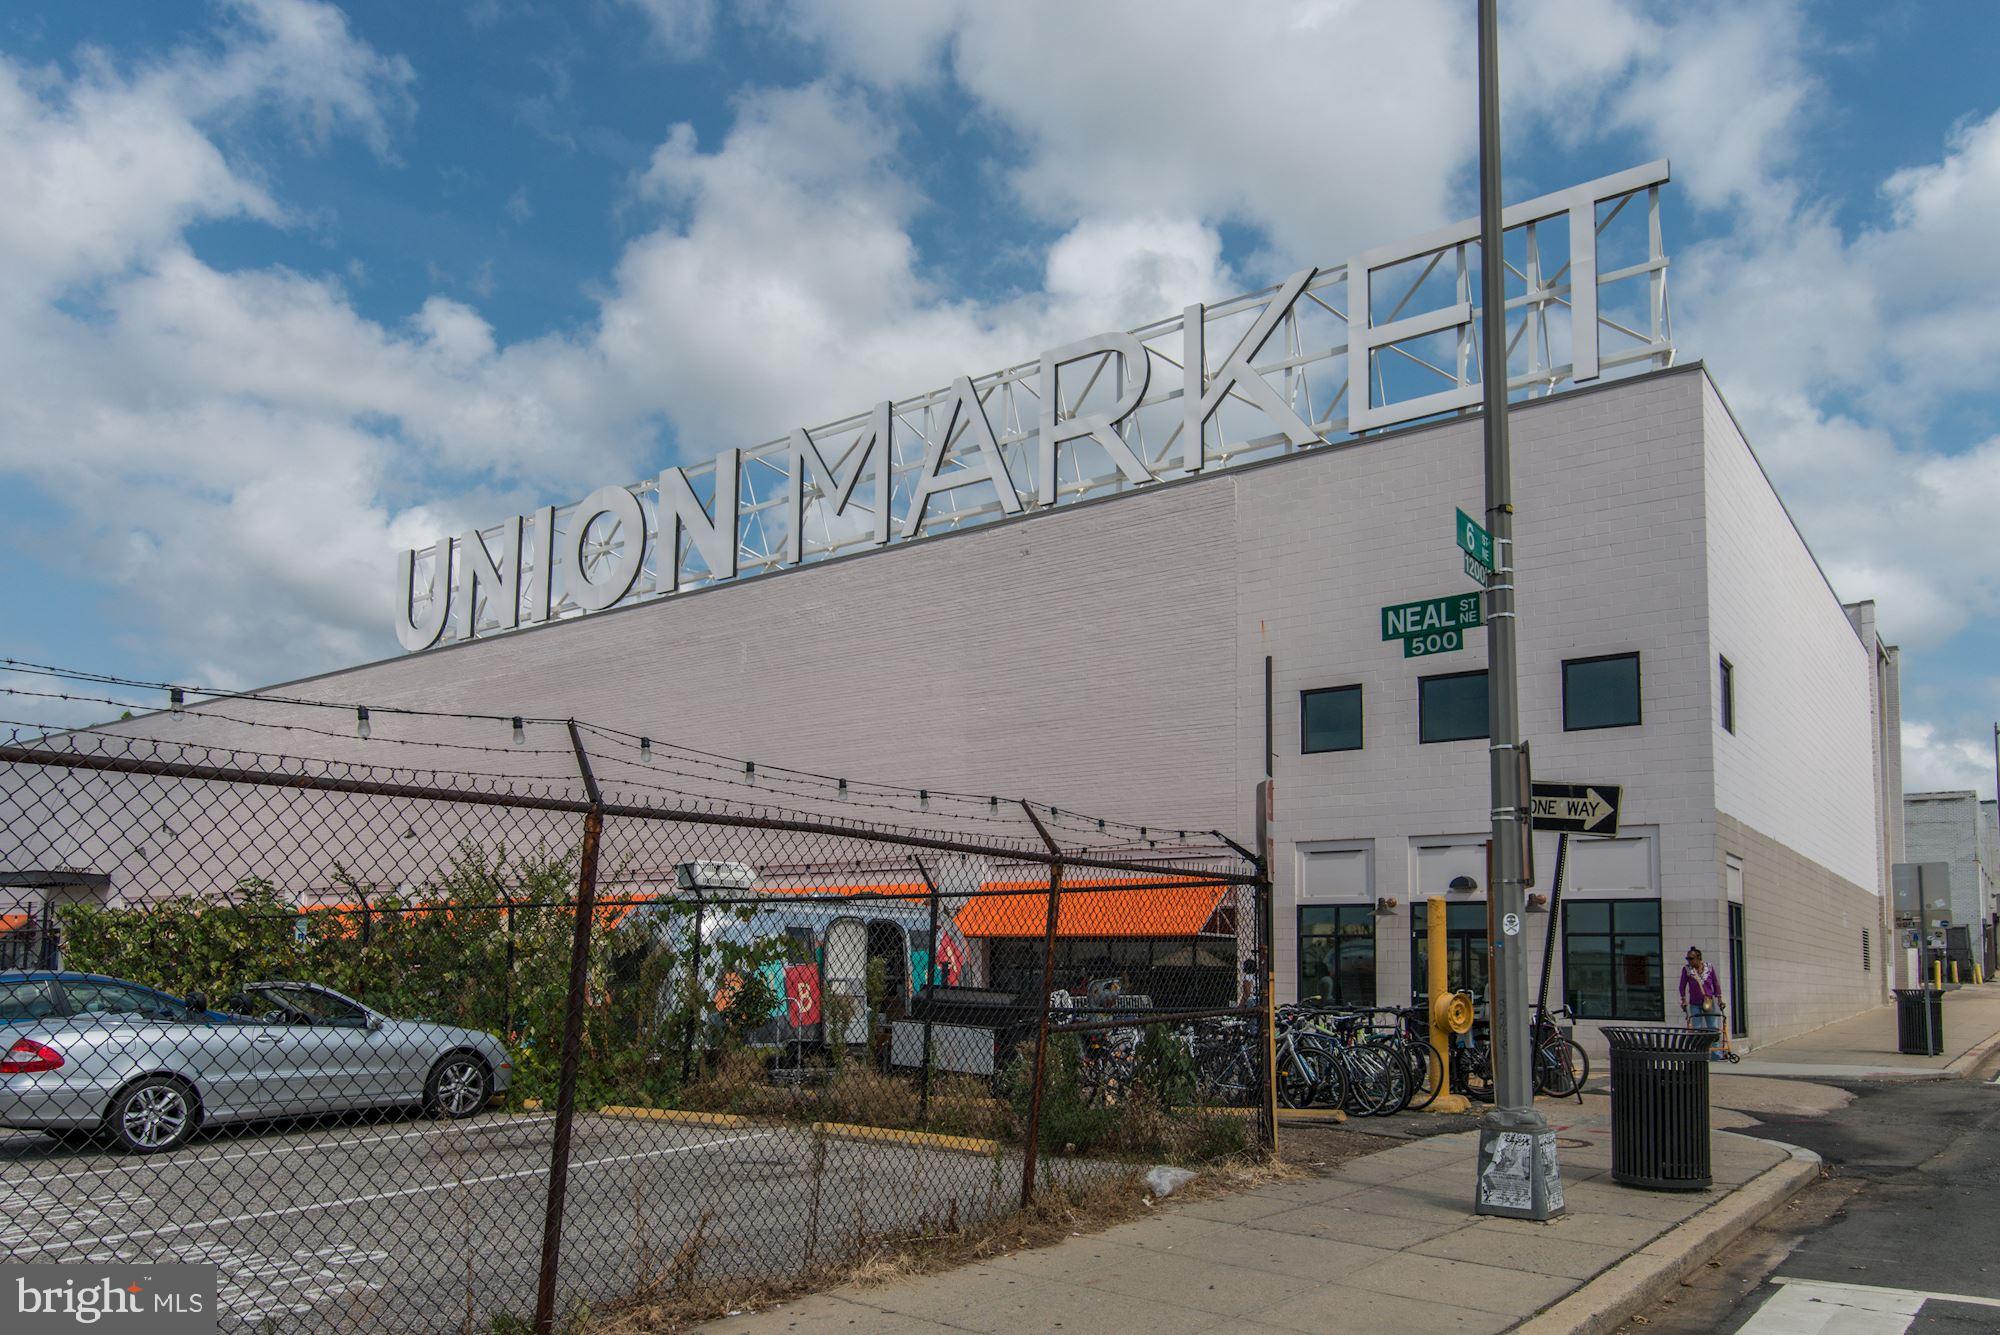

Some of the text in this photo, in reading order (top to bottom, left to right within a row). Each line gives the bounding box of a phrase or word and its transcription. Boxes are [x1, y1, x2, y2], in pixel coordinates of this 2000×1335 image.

[395, 158, 1671, 652] UNION MARKET
[1466, 522, 1489, 551] 6 ST
[1465, 555, 1486, 584] 1200
[1387, 598, 1477, 635] NEAL ST
[1460, 610, 1478, 624] NE
[1411, 631, 1458, 655] 500
[1531, 799, 1600, 817] ONE WAY
